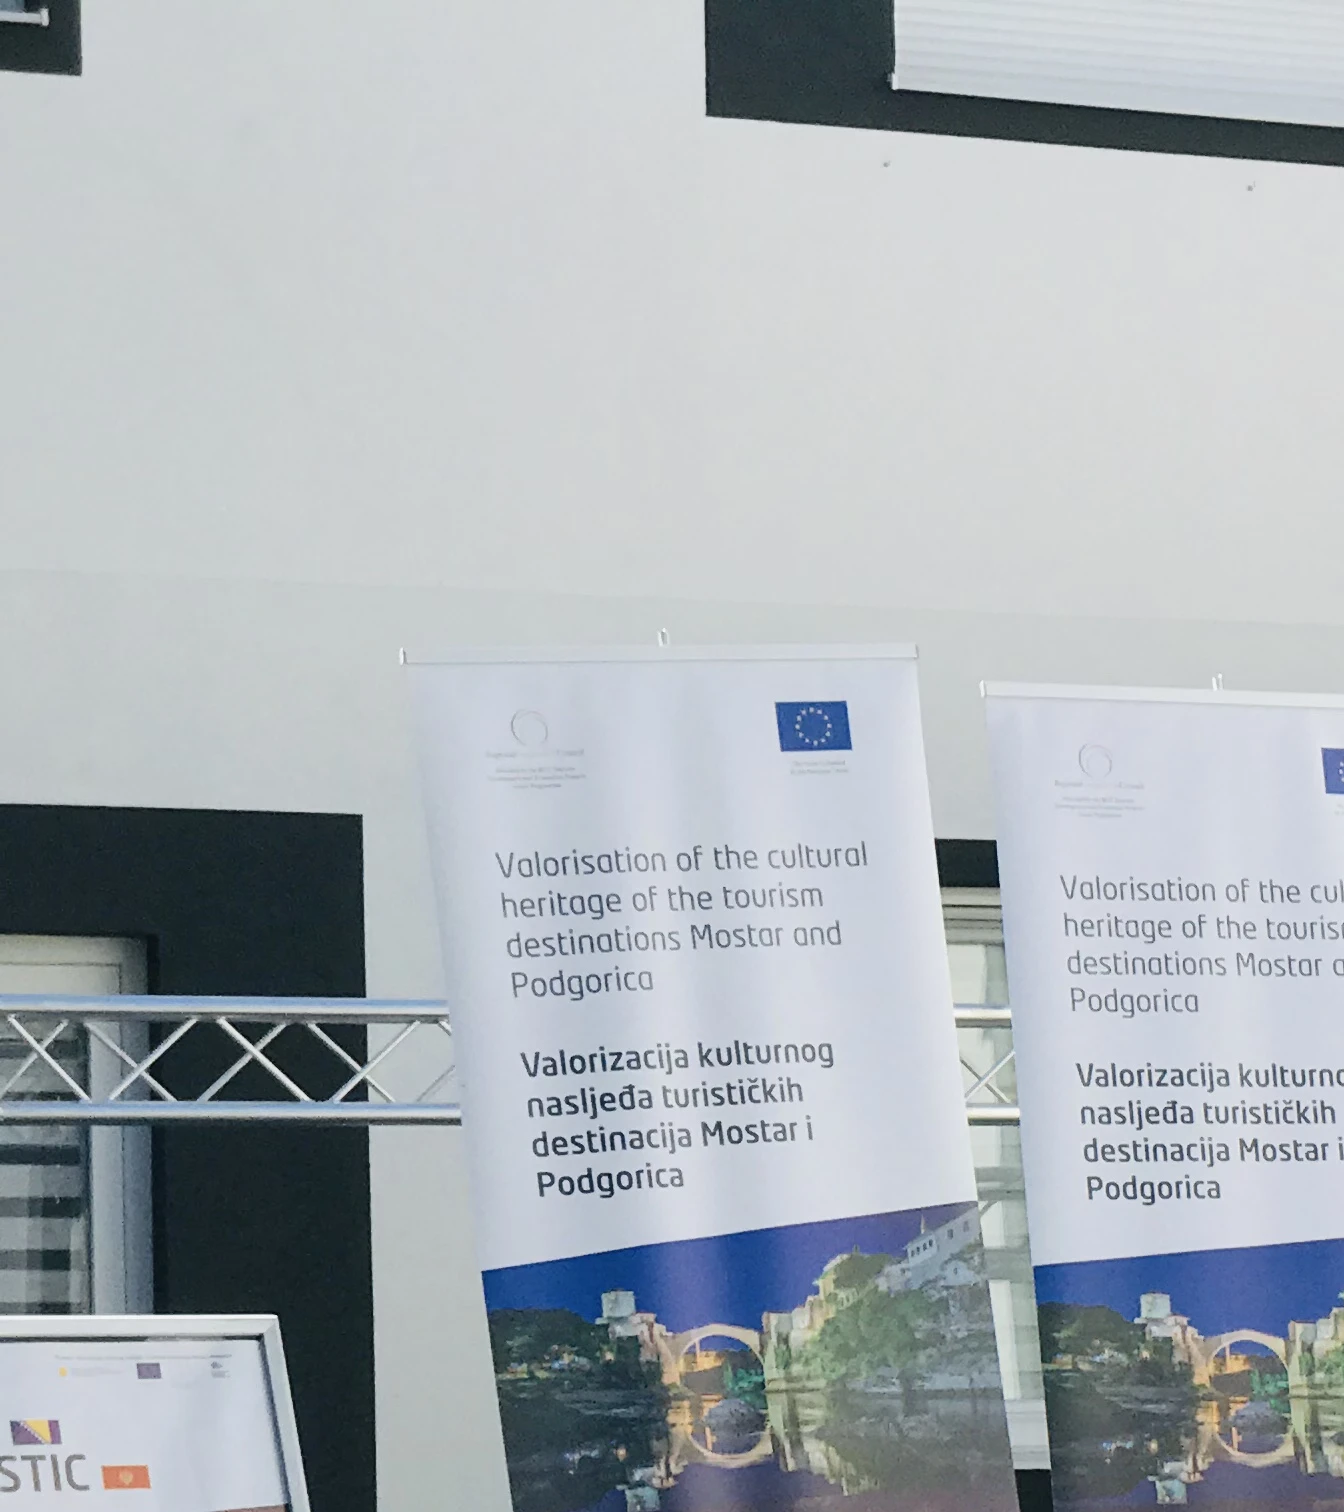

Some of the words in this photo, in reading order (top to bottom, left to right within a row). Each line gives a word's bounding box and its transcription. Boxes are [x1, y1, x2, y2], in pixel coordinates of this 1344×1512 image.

[494, 845, 667, 879] Valorisation
[676, 844, 704, 874] of
[713, 843, 759, 871] the
[767, 840, 869, 869] cultural
[500, 890, 622, 921] heritage
[632, 885, 659, 913] of
[667, 884, 714, 913] the
[721, 881, 825, 911] tourism
[1059, 874, 1217, 902] Valorisation
[1225, 877, 1250, 903] of
[1258, 878, 1301, 905] the
[505, 924, 682, 959] destinations
[690, 922, 785, 951] Mostar
[793, 919, 843, 947] and
[1062, 911, 1173, 945] heritage
[1181, 913, 1207, 940] of
[1216, 915, 1258, 941] the
[1066, 949, 1228, 977] destinations
[1236, 951, 1323, 978] Mostar
[510, 965, 655, 1002] Podgorica
[1069, 986, 1200, 1019] Podgorica
[520, 1041, 690, 1078] Valorizacija
[697, 1039, 835, 1069] kulturnog
[1075, 1061, 1231, 1093] Valorizacija
[526, 1083, 654, 1120] nasljeđa
[661, 1076, 804, 1110] turističkih
[1079, 1099, 1195, 1131] nasljeđa
[1202, 1099, 1336, 1126] turističkih
[531, 1121, 693, 1158] destinacija
[700, 1118, 798, 1147] Mostar
[805, 1114, 814, 1141] i
[1083, 1136, 1231, 1168] destinacija
[1238, 1137, 1329, 1162] Mostar
[1337, 1135, 1344, 1161] i
[536, 1162, 685, 1199] Podgorica
[1086, 1173, 1222, 1206] Podgorica
[0, 1453, 91, 1493] STIC
